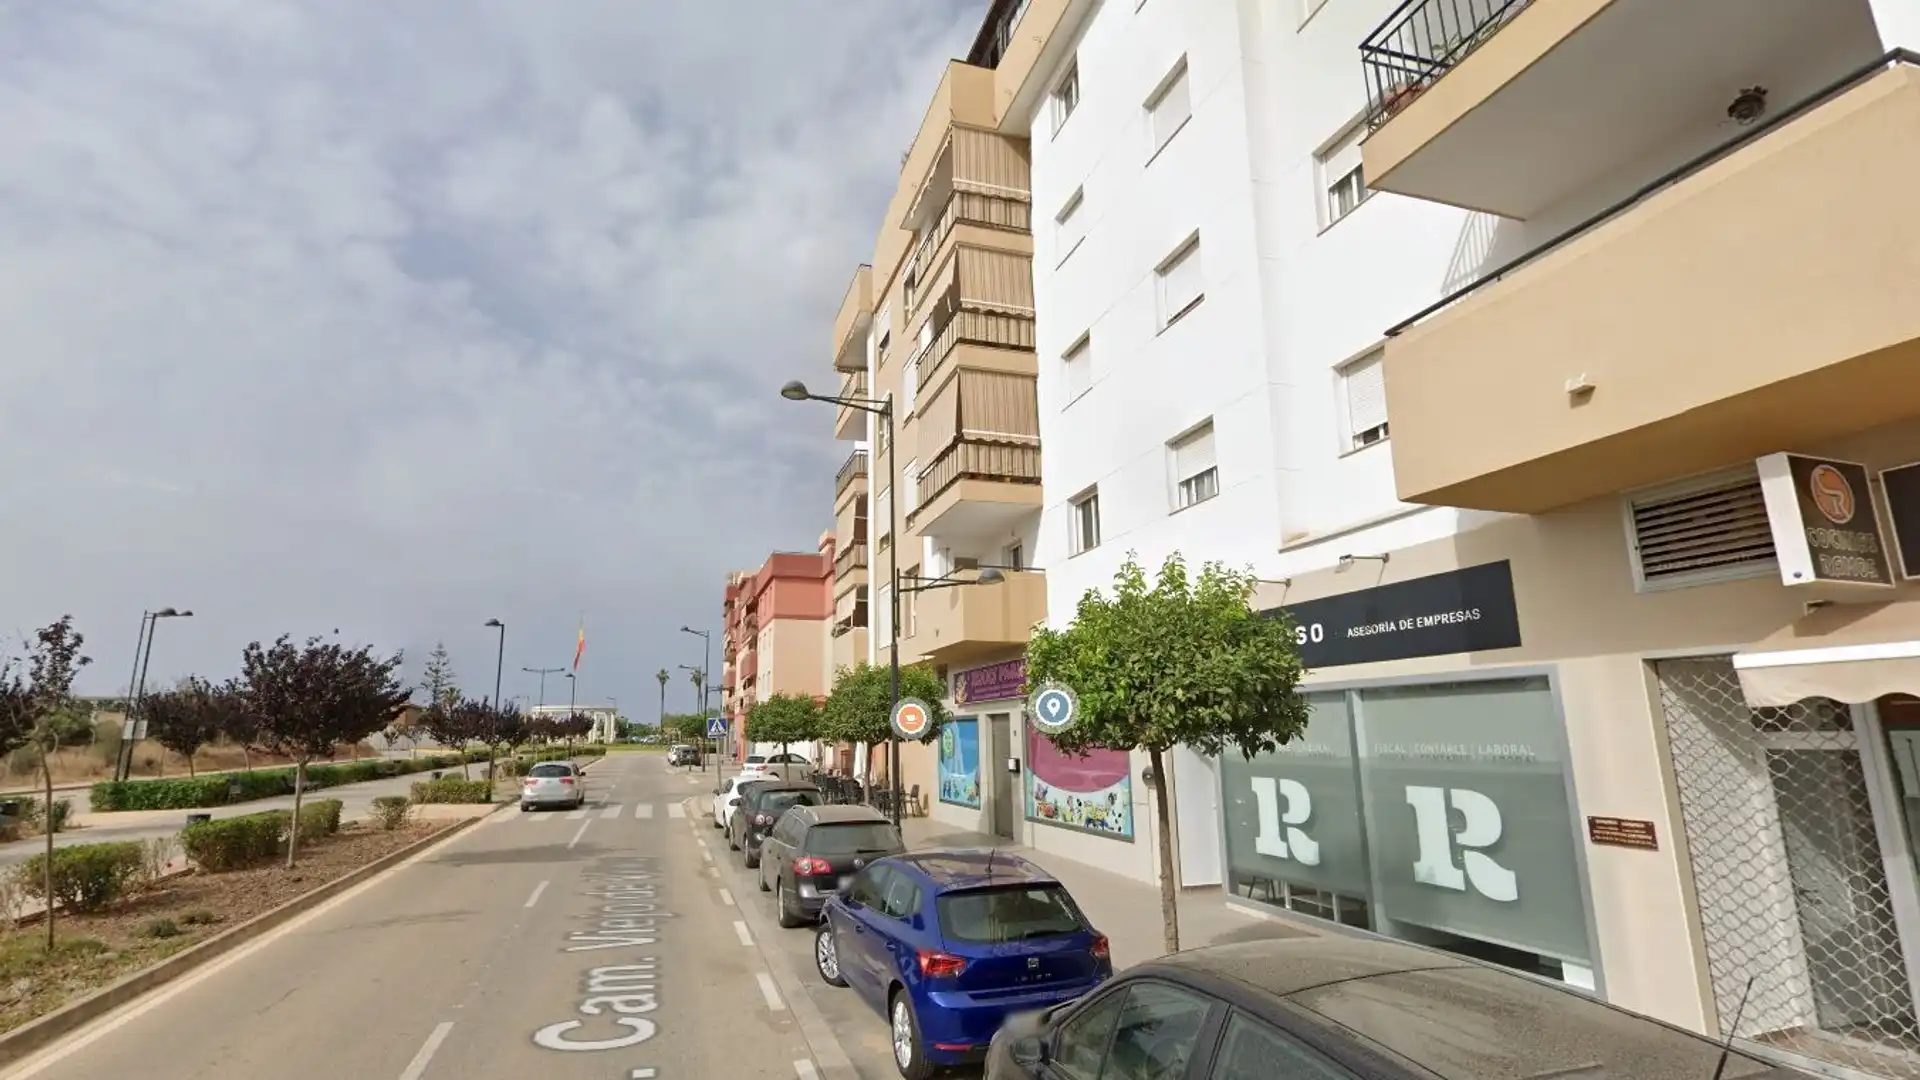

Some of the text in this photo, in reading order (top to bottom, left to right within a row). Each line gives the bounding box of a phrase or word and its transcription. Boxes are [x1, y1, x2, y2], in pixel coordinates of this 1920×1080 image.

[1400, 618, 1414, 631] DE
[1417, 608, 1481, 628] EMPRESAS
[1295, 623, 1324, 645] SO
[1478, 743, 1536, 757] LABORAL
[1251, 776, 1320, 866] R
[1405, 785, 1519, 902] R
